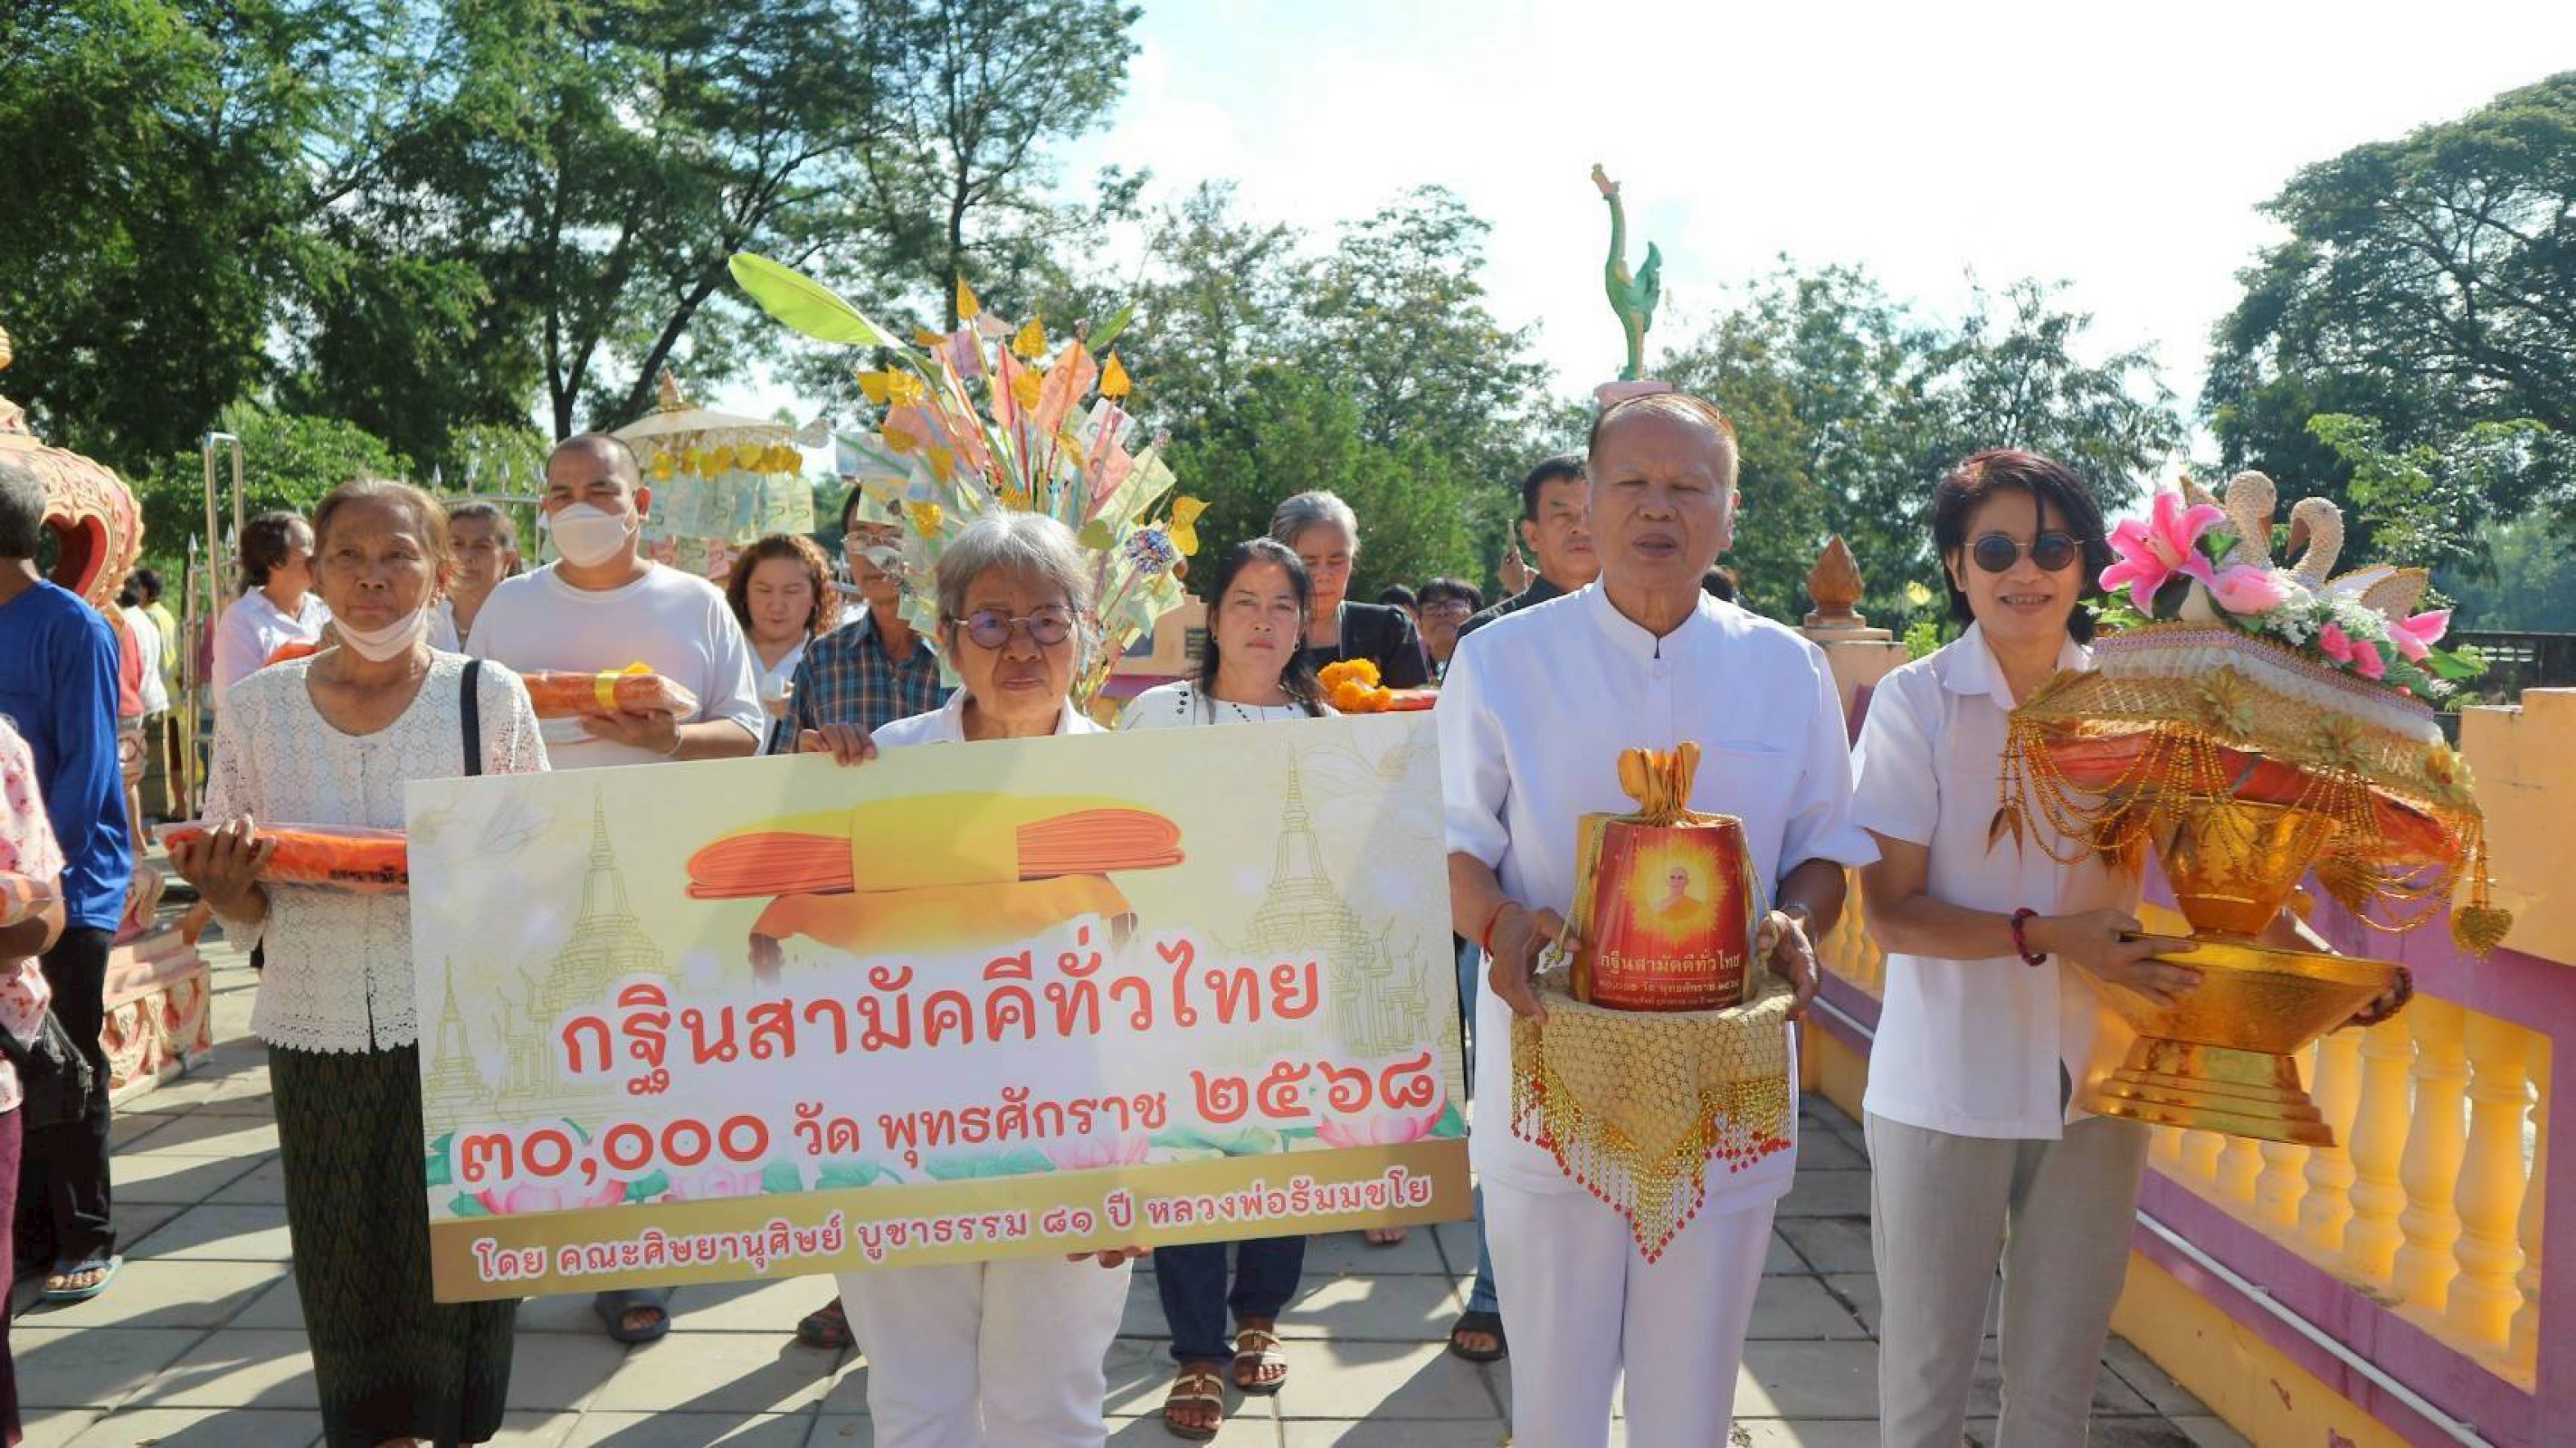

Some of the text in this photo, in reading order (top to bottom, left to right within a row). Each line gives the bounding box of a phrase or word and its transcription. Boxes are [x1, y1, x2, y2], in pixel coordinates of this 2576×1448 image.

[563, 926, 1318, 1094] กฐินสามัคคีทั่วไทย
[461, 1052, 1435, 1186] ๓๐,๐๐๐ วัด พุทธศักราช ๒๕๖๘
[475, 1243, 544, 1278] โดย
[560, 1215, 842, 1270] คณะศิษยานุศิษย์
[858, 1211, 1027, 1260] บูชาธรรม
[1043, 1208, 1093, 1233] ๘๑
[1108, 1192, 1132, 1227] ปี
